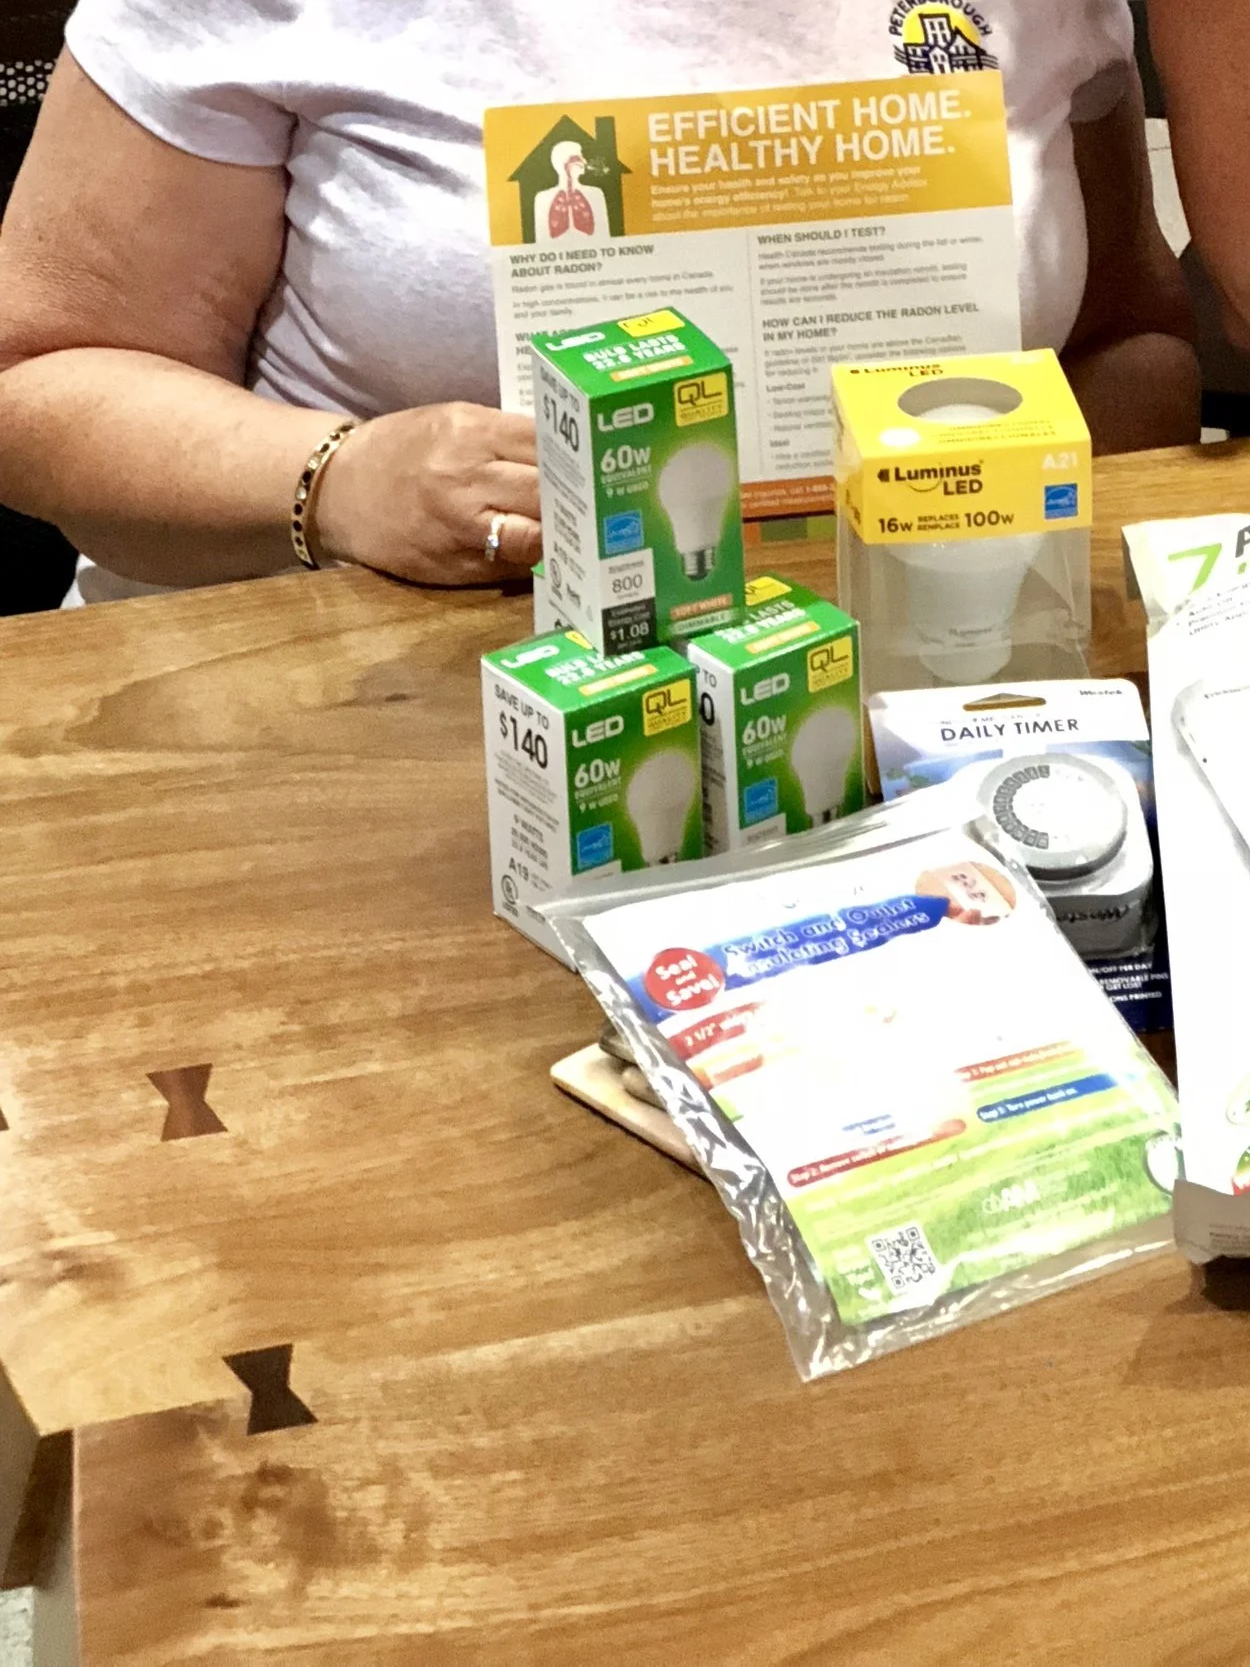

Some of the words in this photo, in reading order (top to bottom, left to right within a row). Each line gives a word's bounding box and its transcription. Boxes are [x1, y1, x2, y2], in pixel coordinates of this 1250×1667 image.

[648, 99, 841, 143] EFFICIENT
[852, 89, 972, 128] HOME.
[650, 135, 824, 178] HEALTHY
[835, 125, 956, 164] HOME.
[757, 233, 792, 245] WHEN
[794, 229, 841, 243] SHOULD
[852, 226, 886, 237] TEST?
[510, 254, 535, 265] WHY
[539, 252, 556, 263] DO
[566, 249, 597, 261] NEED
[600, 247, 615, 258] TO
[618, 244, 654, 256] KNOW
[511, 265, 551, 278] ABOUT
[554, 262, 603, 276] RADON?
[762, 317, 789, 329] HOW
[792, 315, 817, 327] CAN
[826, 311, 873, 324] REDUCE
[876, 309, 895, 321] THE
[900, 305, 941, 318] RADON
[944, 303, 979, 315] LEVEL
[763, 332, 774, 342] IN
[777, 330, 793, 341] MY
[797, 327, 838, 340] HOME?
[677, 381, 723, 407] QL
[543, 394, 580, 452] $140
[597, 402, 655, 432] LED
[1042, 452, 1079, 471] A21
[943, 478, 984, 496] LED
[612, 573, 644, 593] 800
[609, 622, 650, 641] $1.08
[809, 647, 850, 673] QL
[703, 669, 718, 689] TO
[739, 672, 791, 706] LED
[495, 683, 519, 712] SAVE
[520, 700, 534, 719] UP
[535, 708, 549, 731] TO
[645, 689, 687, 716] QL
[499, 710, 549, 770] $140
[571, 714, 625, 748] LED
[940, 724, 1006, 742] DAILY
[1014, 718, 1079, 735] TIMER
[509, 856, 530, 882] A19
[724, 929, 798, 957] Switch
[803, 917, 847, 940] and
[847, 898, 916, 929] Outlet
[656, 954, 698, 981] Seal
[747, 935, 848, 974] nsulating
[675, 971, 696, 986] and
